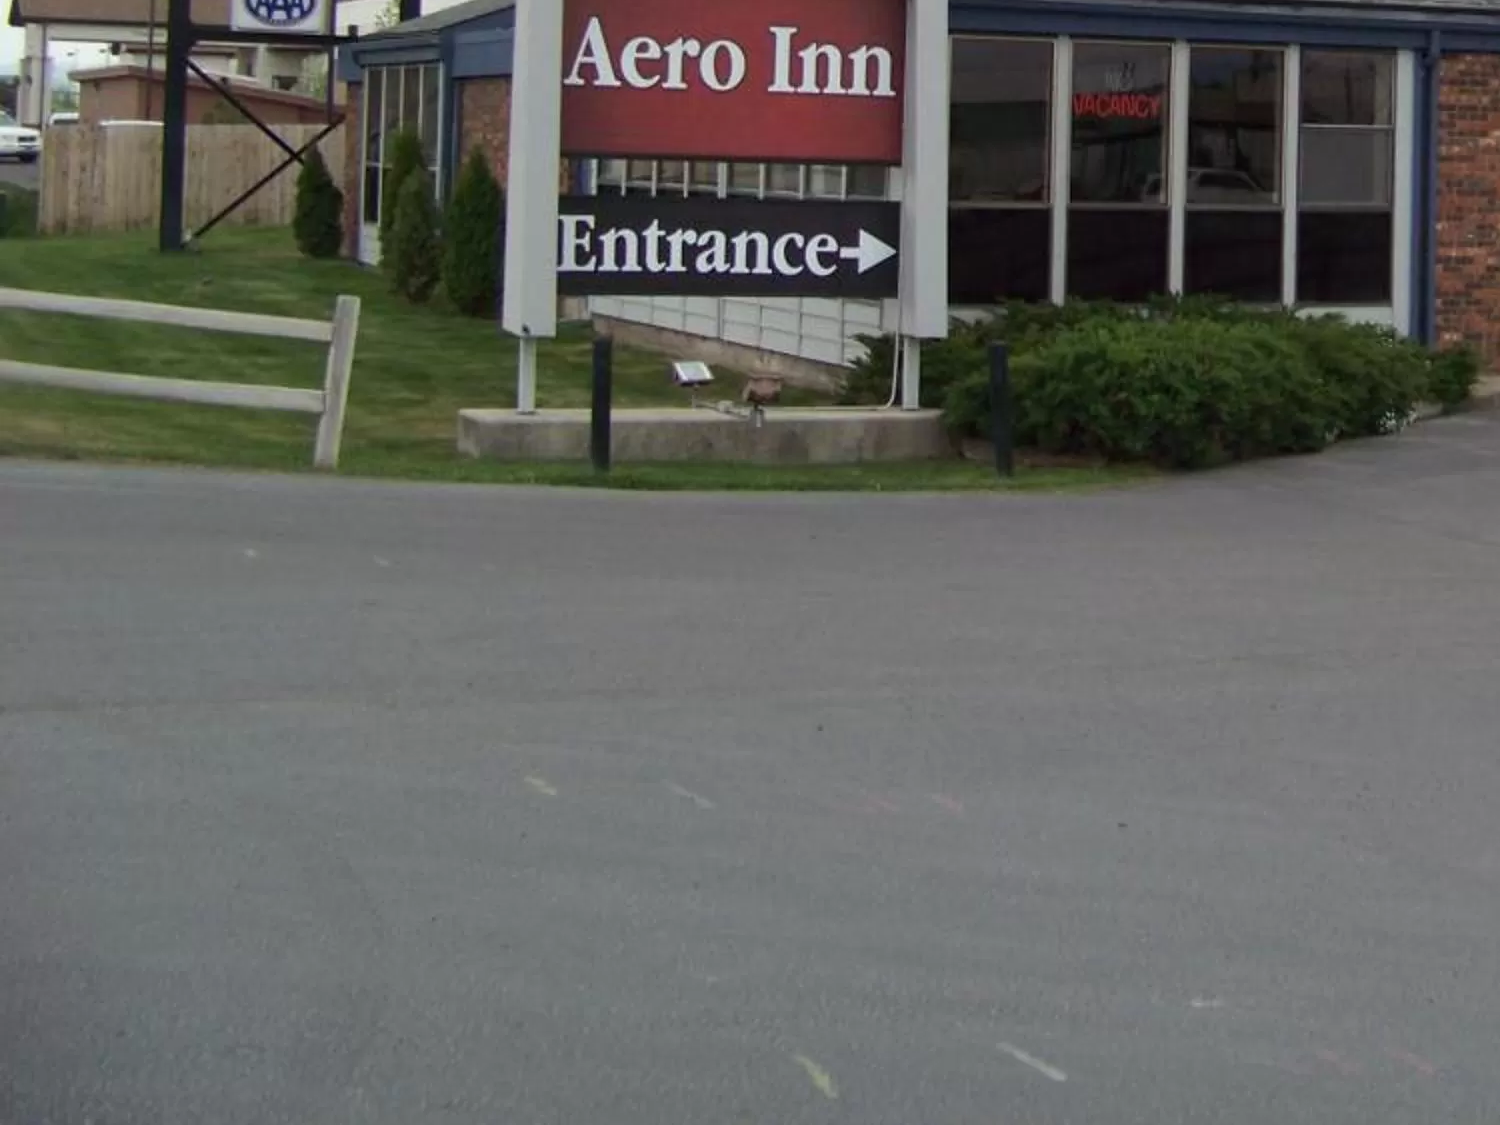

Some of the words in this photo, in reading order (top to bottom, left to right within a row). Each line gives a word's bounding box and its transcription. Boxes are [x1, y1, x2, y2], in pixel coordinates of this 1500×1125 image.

[562, 14, 747, 93] Aero
[767, 25, 897, 97] Inn
[1073, 92, 1161, 118] VACANCY
[556, 214, 841, 277] Entrance
